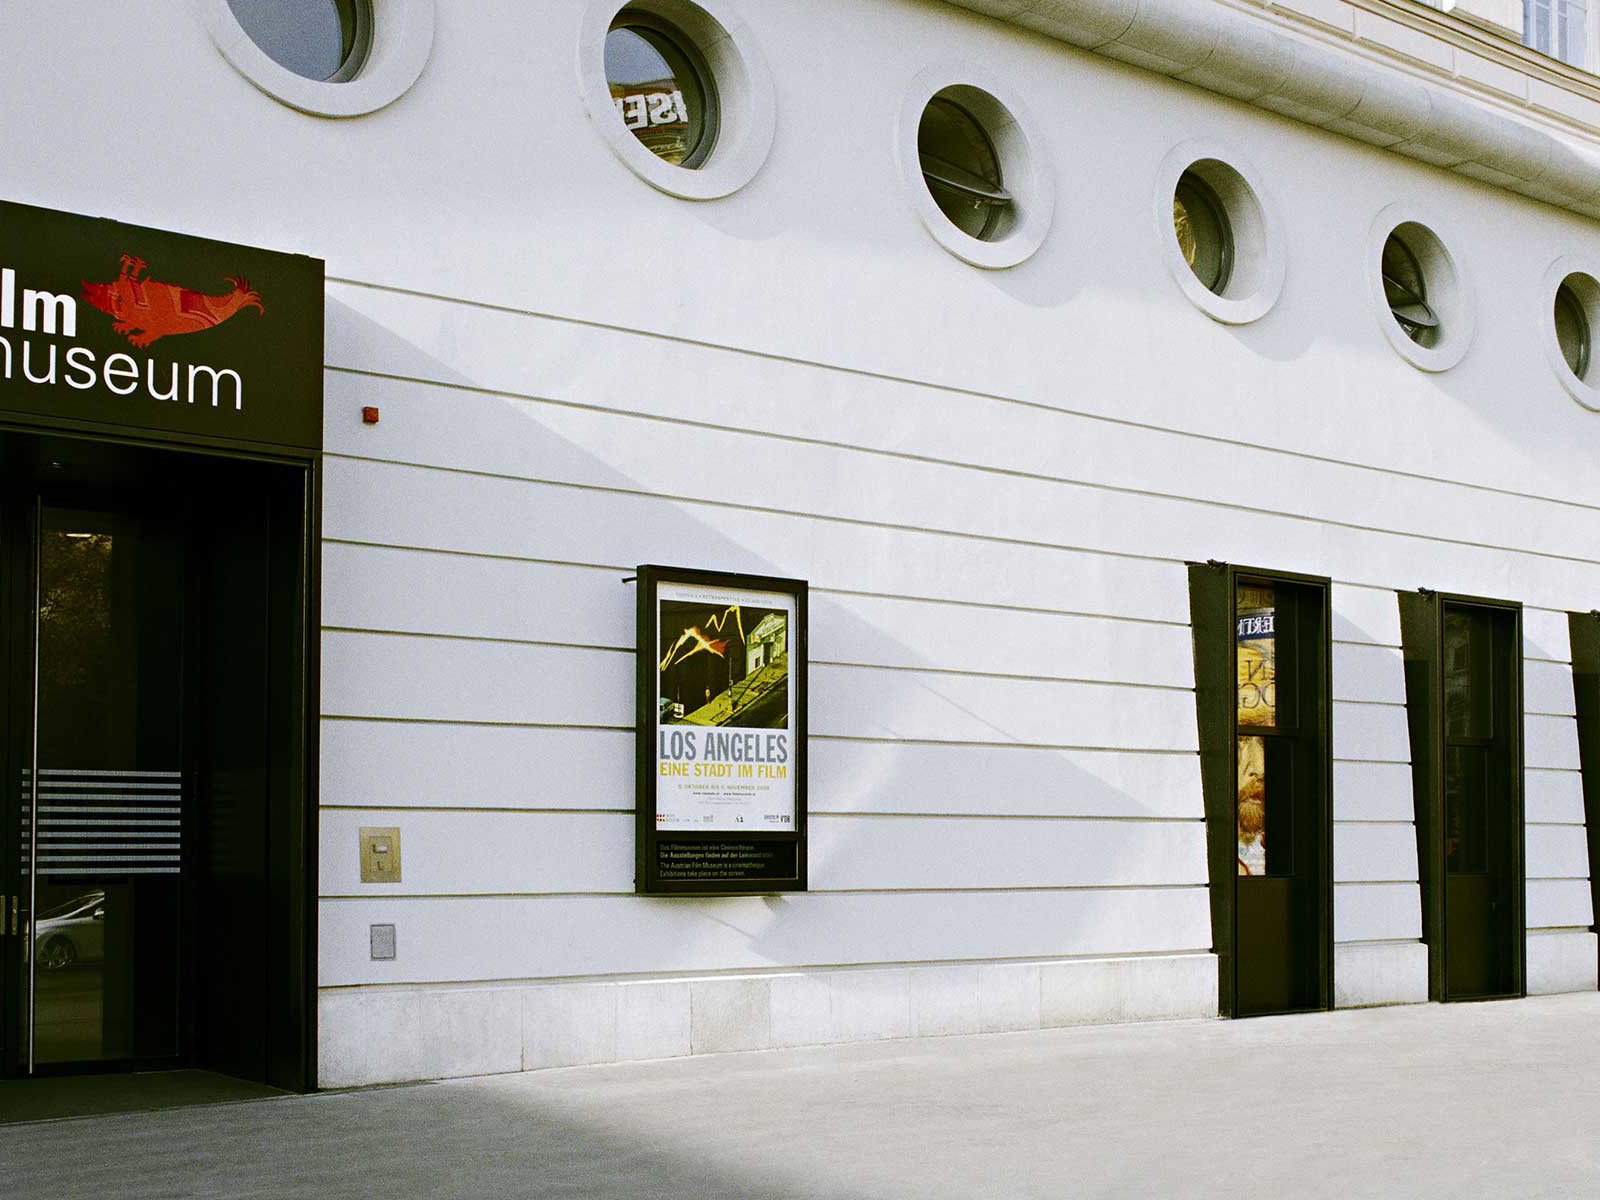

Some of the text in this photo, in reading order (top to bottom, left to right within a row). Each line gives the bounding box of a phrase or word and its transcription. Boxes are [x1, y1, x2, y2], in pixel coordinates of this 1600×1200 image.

[0, 335, 242, 411] useum
[660, 731, 788, 763] LOS ANGELES
[660, 762, 787, 779] EINE STADT IM FILM
